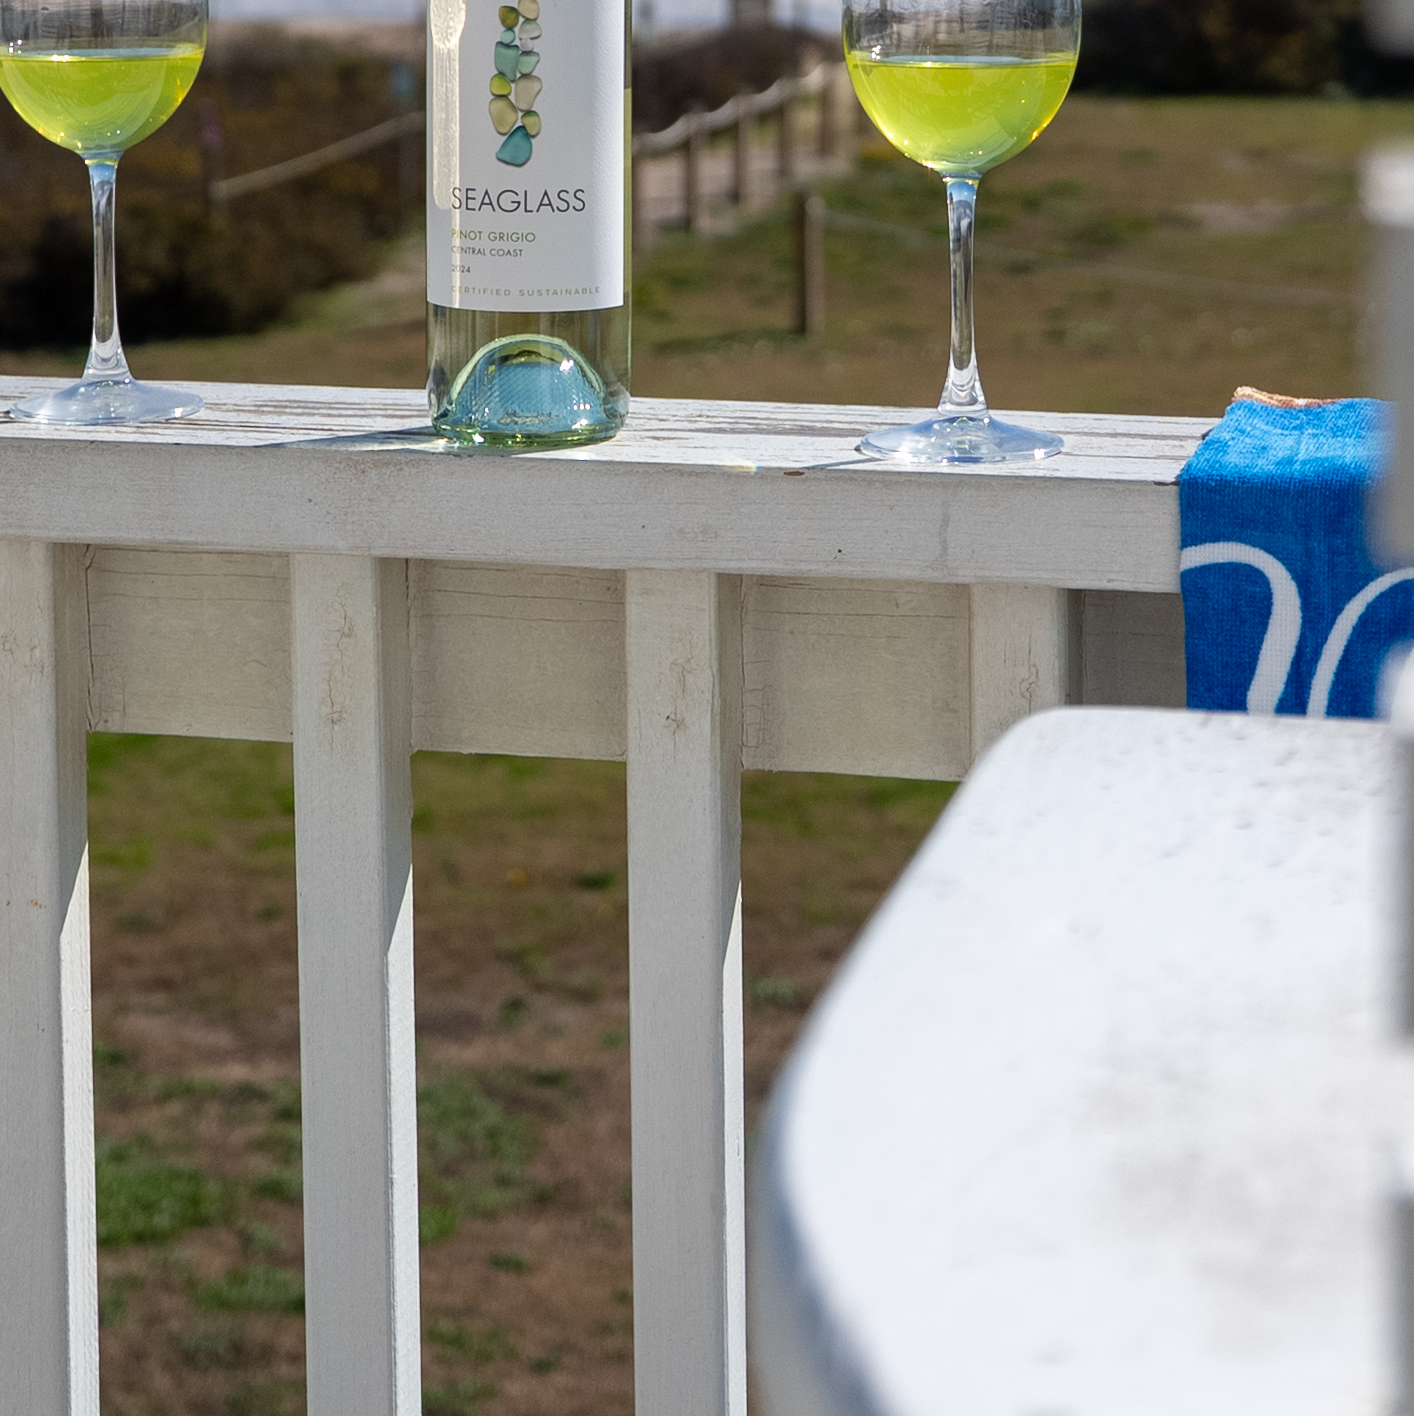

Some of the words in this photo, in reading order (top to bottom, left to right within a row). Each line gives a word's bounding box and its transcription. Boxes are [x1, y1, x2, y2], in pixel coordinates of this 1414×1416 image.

[451, 187, 586, 213] SEAGLASS
[451, 228, 483, 241] PINOT
[488, 231, 536, 243] GRIGIO
[451, 245, 487, 256] CENTRAL
[489, 248, 524, 257] COAST
[451, 285, 511, 297] CERTIFIED
[518, 286, 601, 297] SUSTAINABLE
